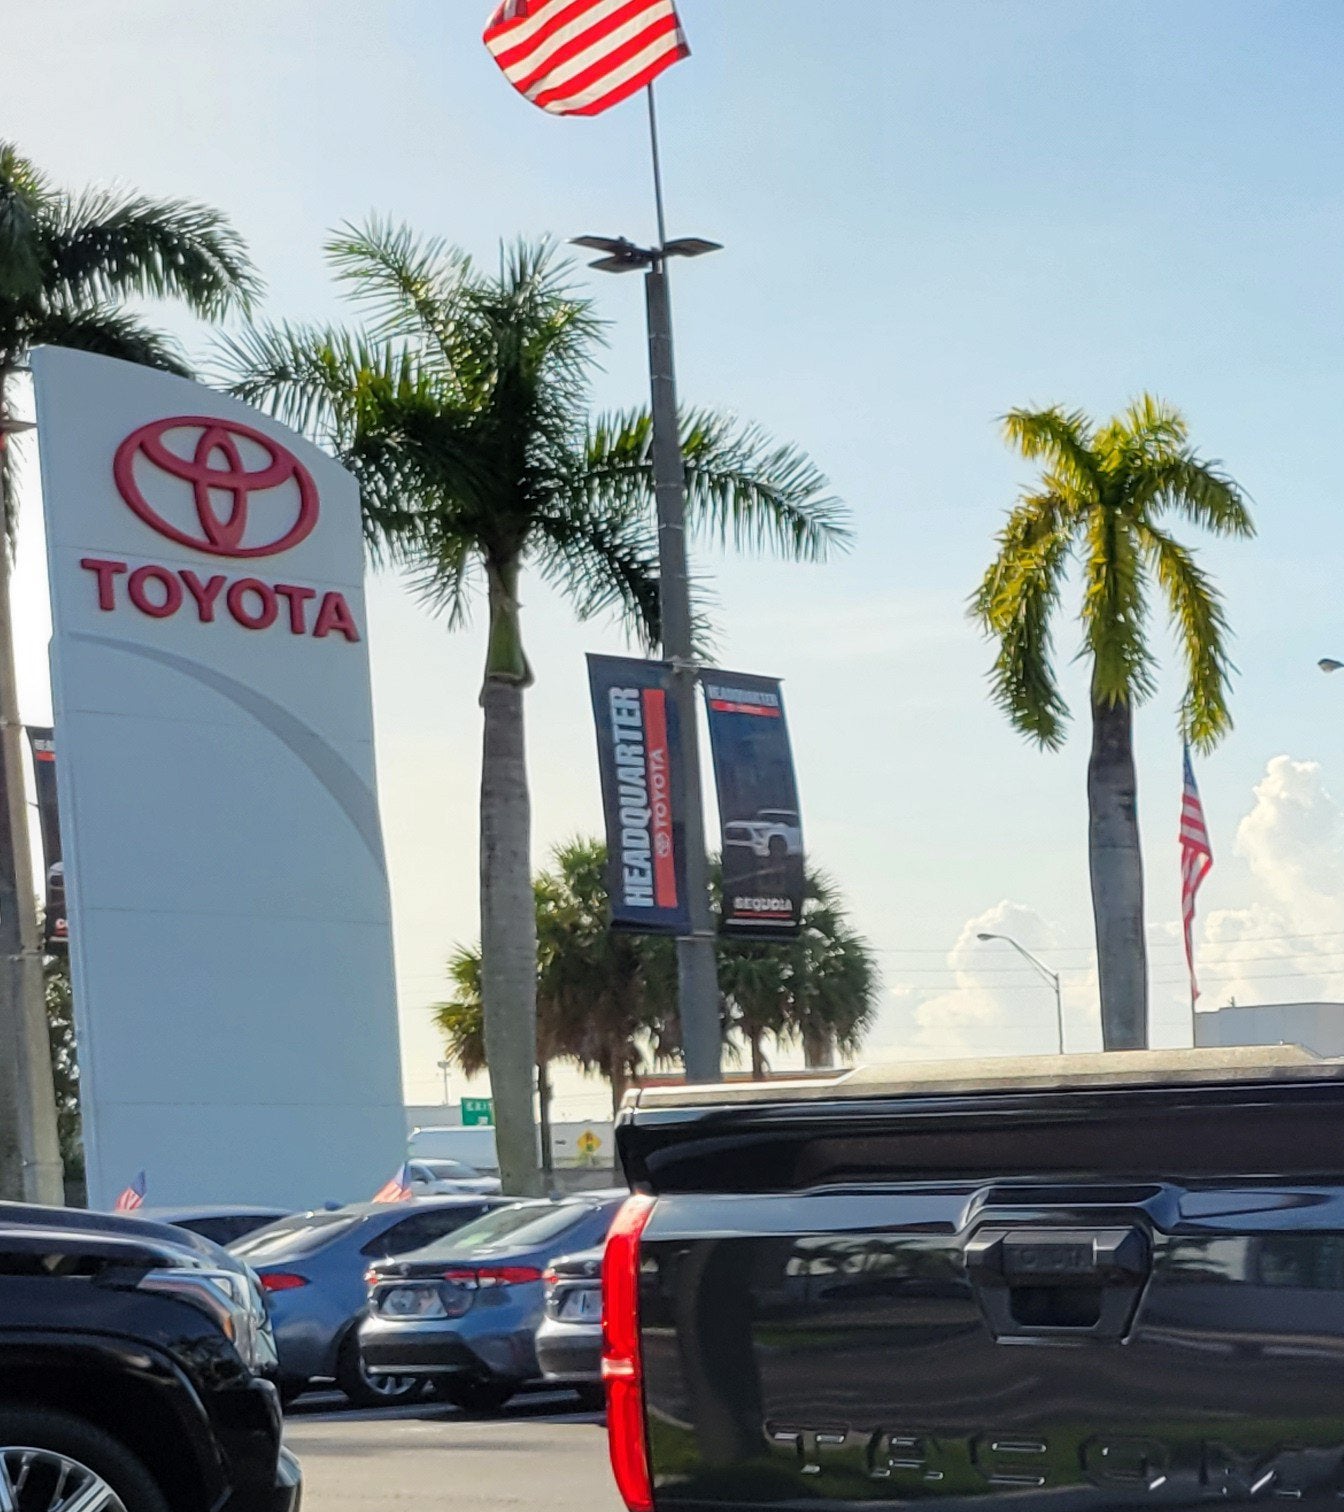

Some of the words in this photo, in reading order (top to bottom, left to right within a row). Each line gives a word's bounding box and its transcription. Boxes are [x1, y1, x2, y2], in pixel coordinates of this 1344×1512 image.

[80, 558, 360, 642] TOYOTA
[609, 686, 654, 907] HEADQUARTER
[650, 748, 670, 828] TOYOTA
[733, 897, 793, 912] SEQUOIA
